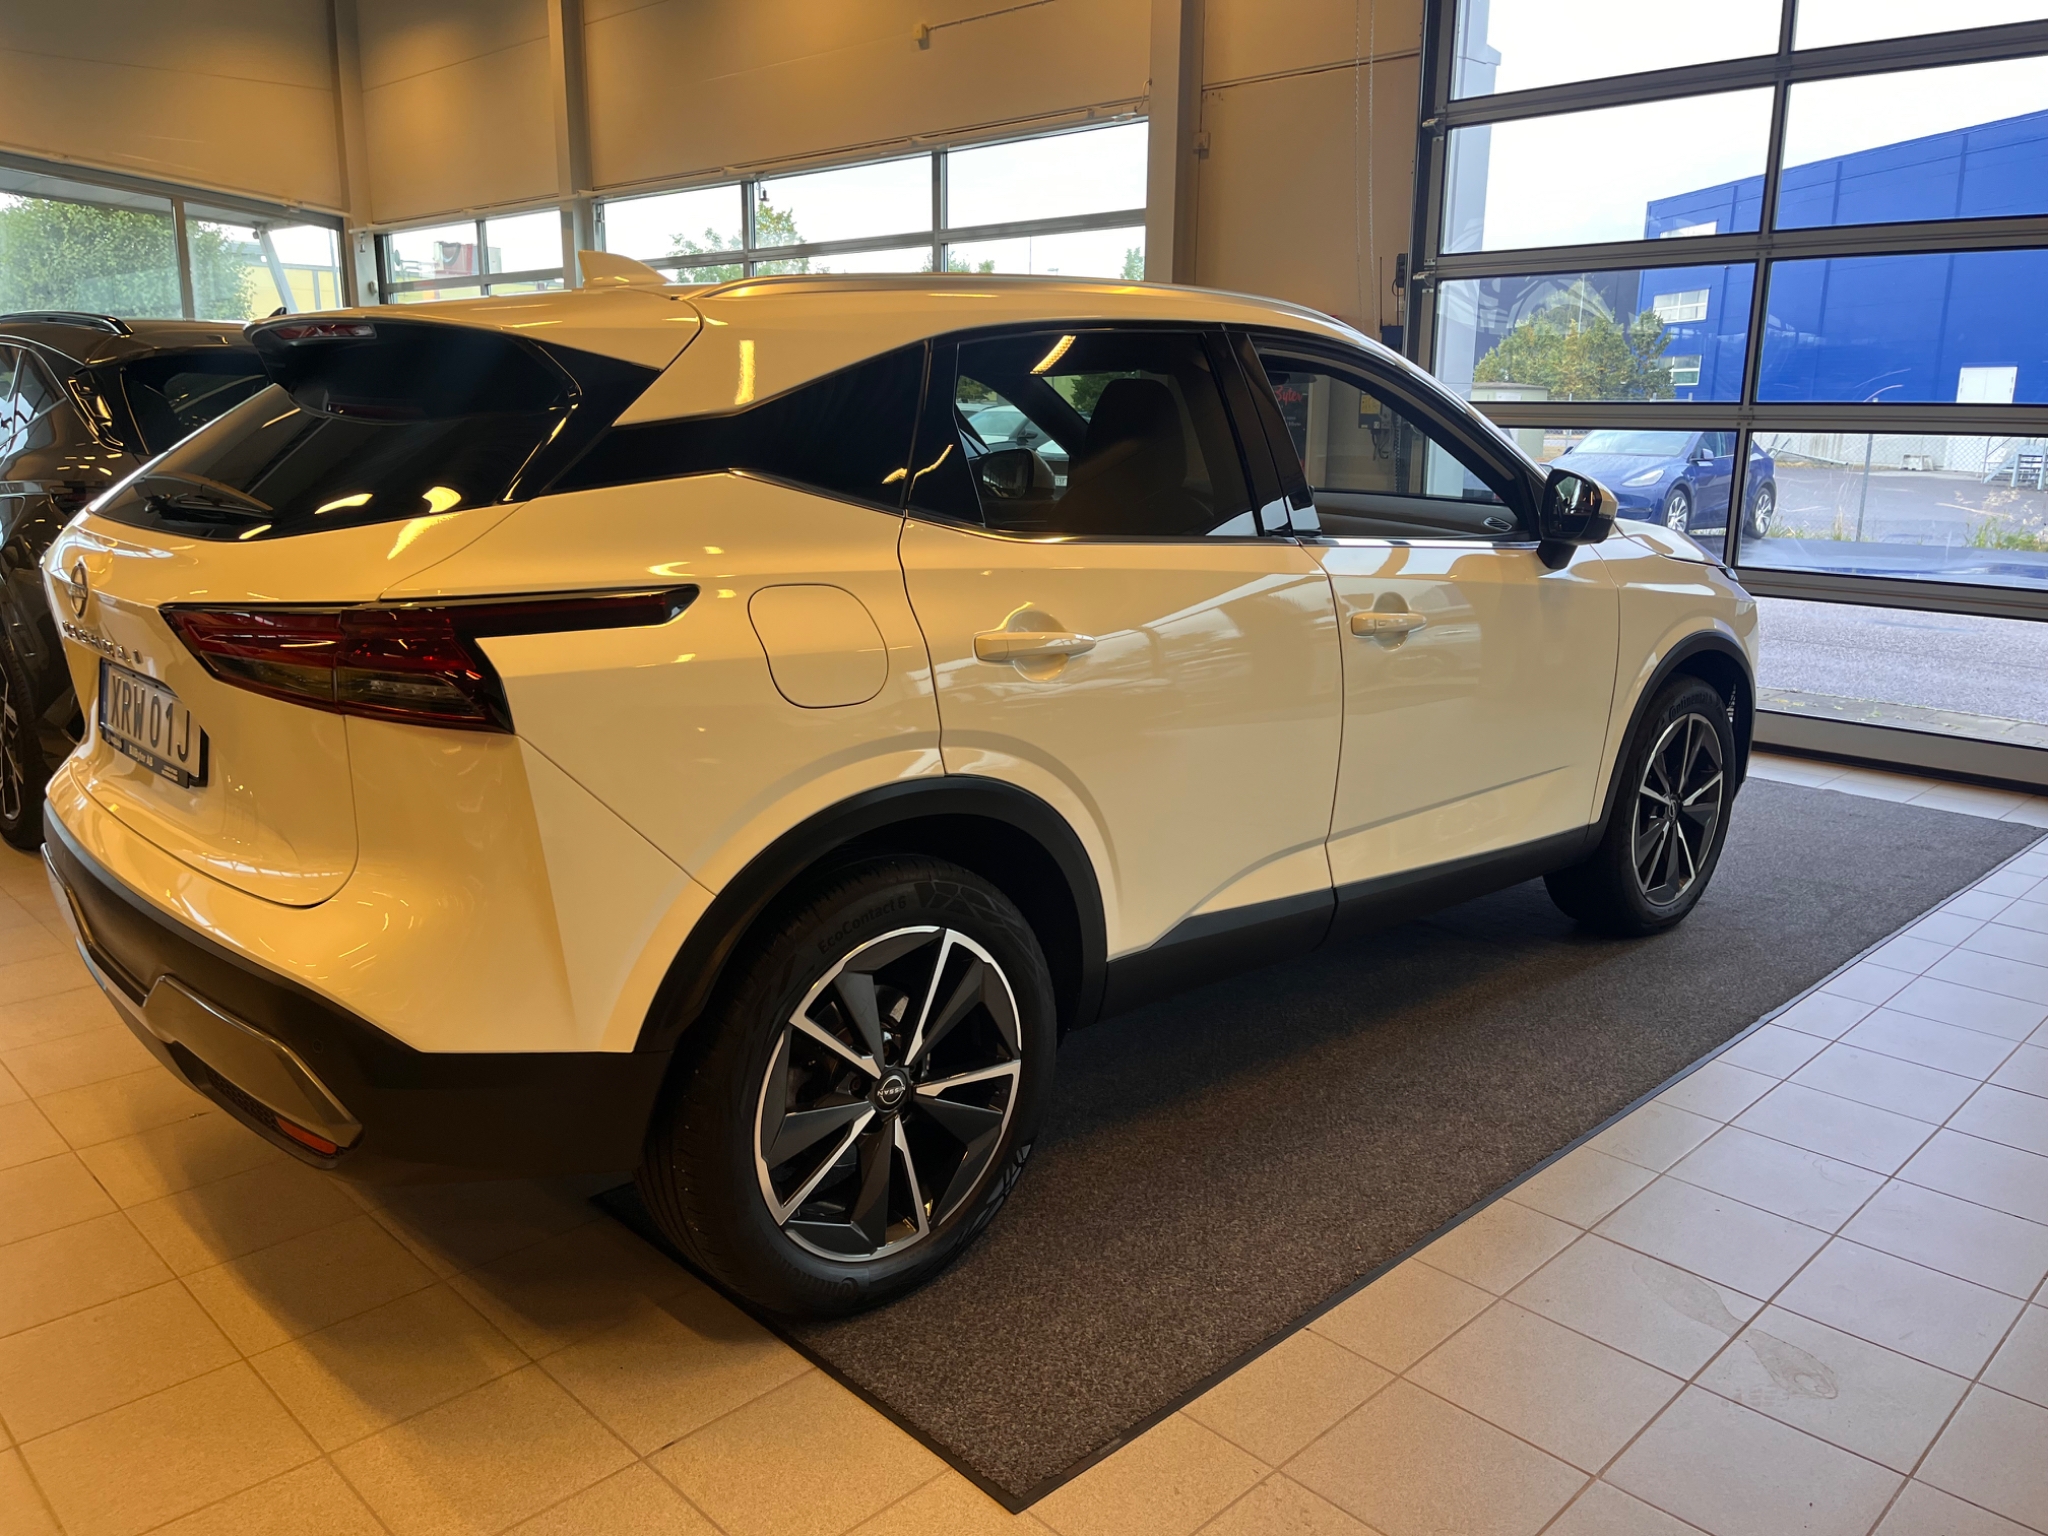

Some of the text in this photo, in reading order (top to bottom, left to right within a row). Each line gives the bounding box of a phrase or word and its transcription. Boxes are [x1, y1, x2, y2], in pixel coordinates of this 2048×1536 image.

[111, 675, 190, 763] XRW 01J
[817, 895, 907, 955] EcoContact 6
[877, 1085, 906, 1096] NISSAN
